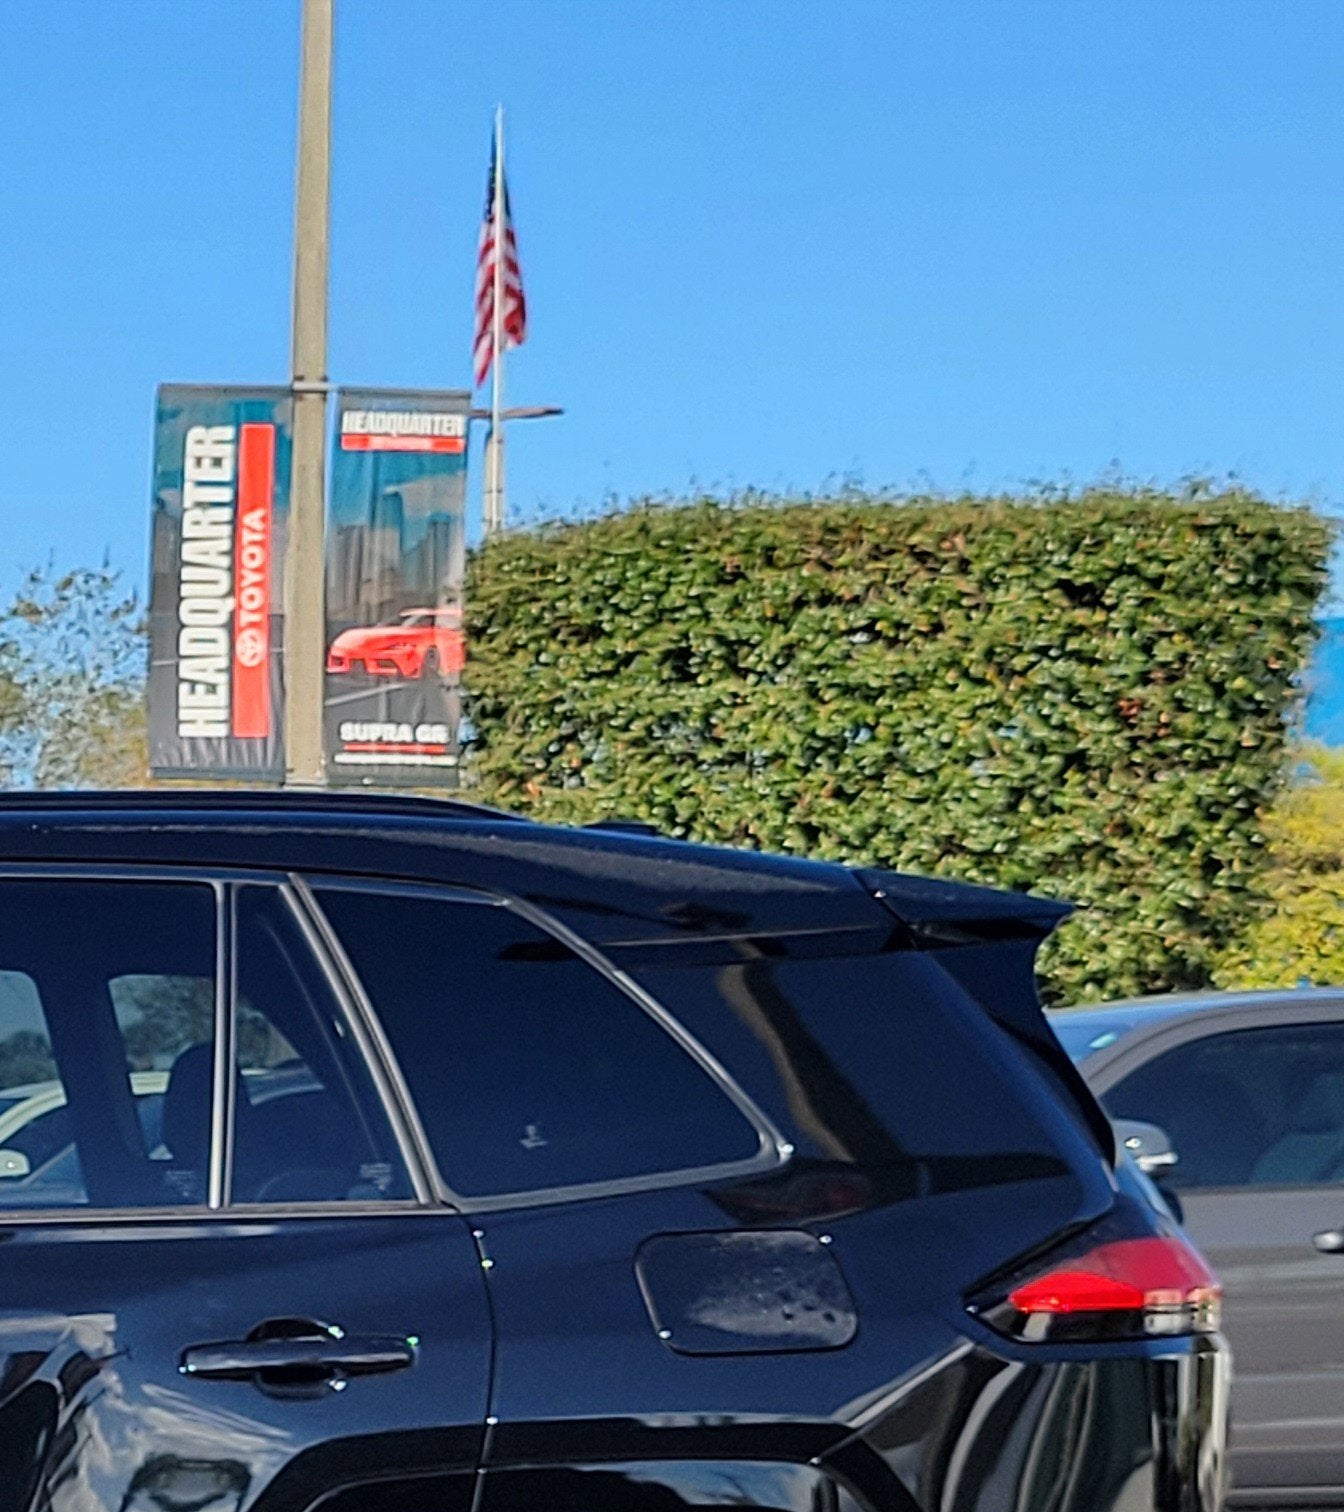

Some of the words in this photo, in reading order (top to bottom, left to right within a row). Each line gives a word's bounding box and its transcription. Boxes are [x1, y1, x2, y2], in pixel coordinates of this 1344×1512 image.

[342, 410, 467, 437] HEADQUARTER
[178, 424, 236, 739] HEADQUARTER
[238, 508, 267, 627] TOYOTA
